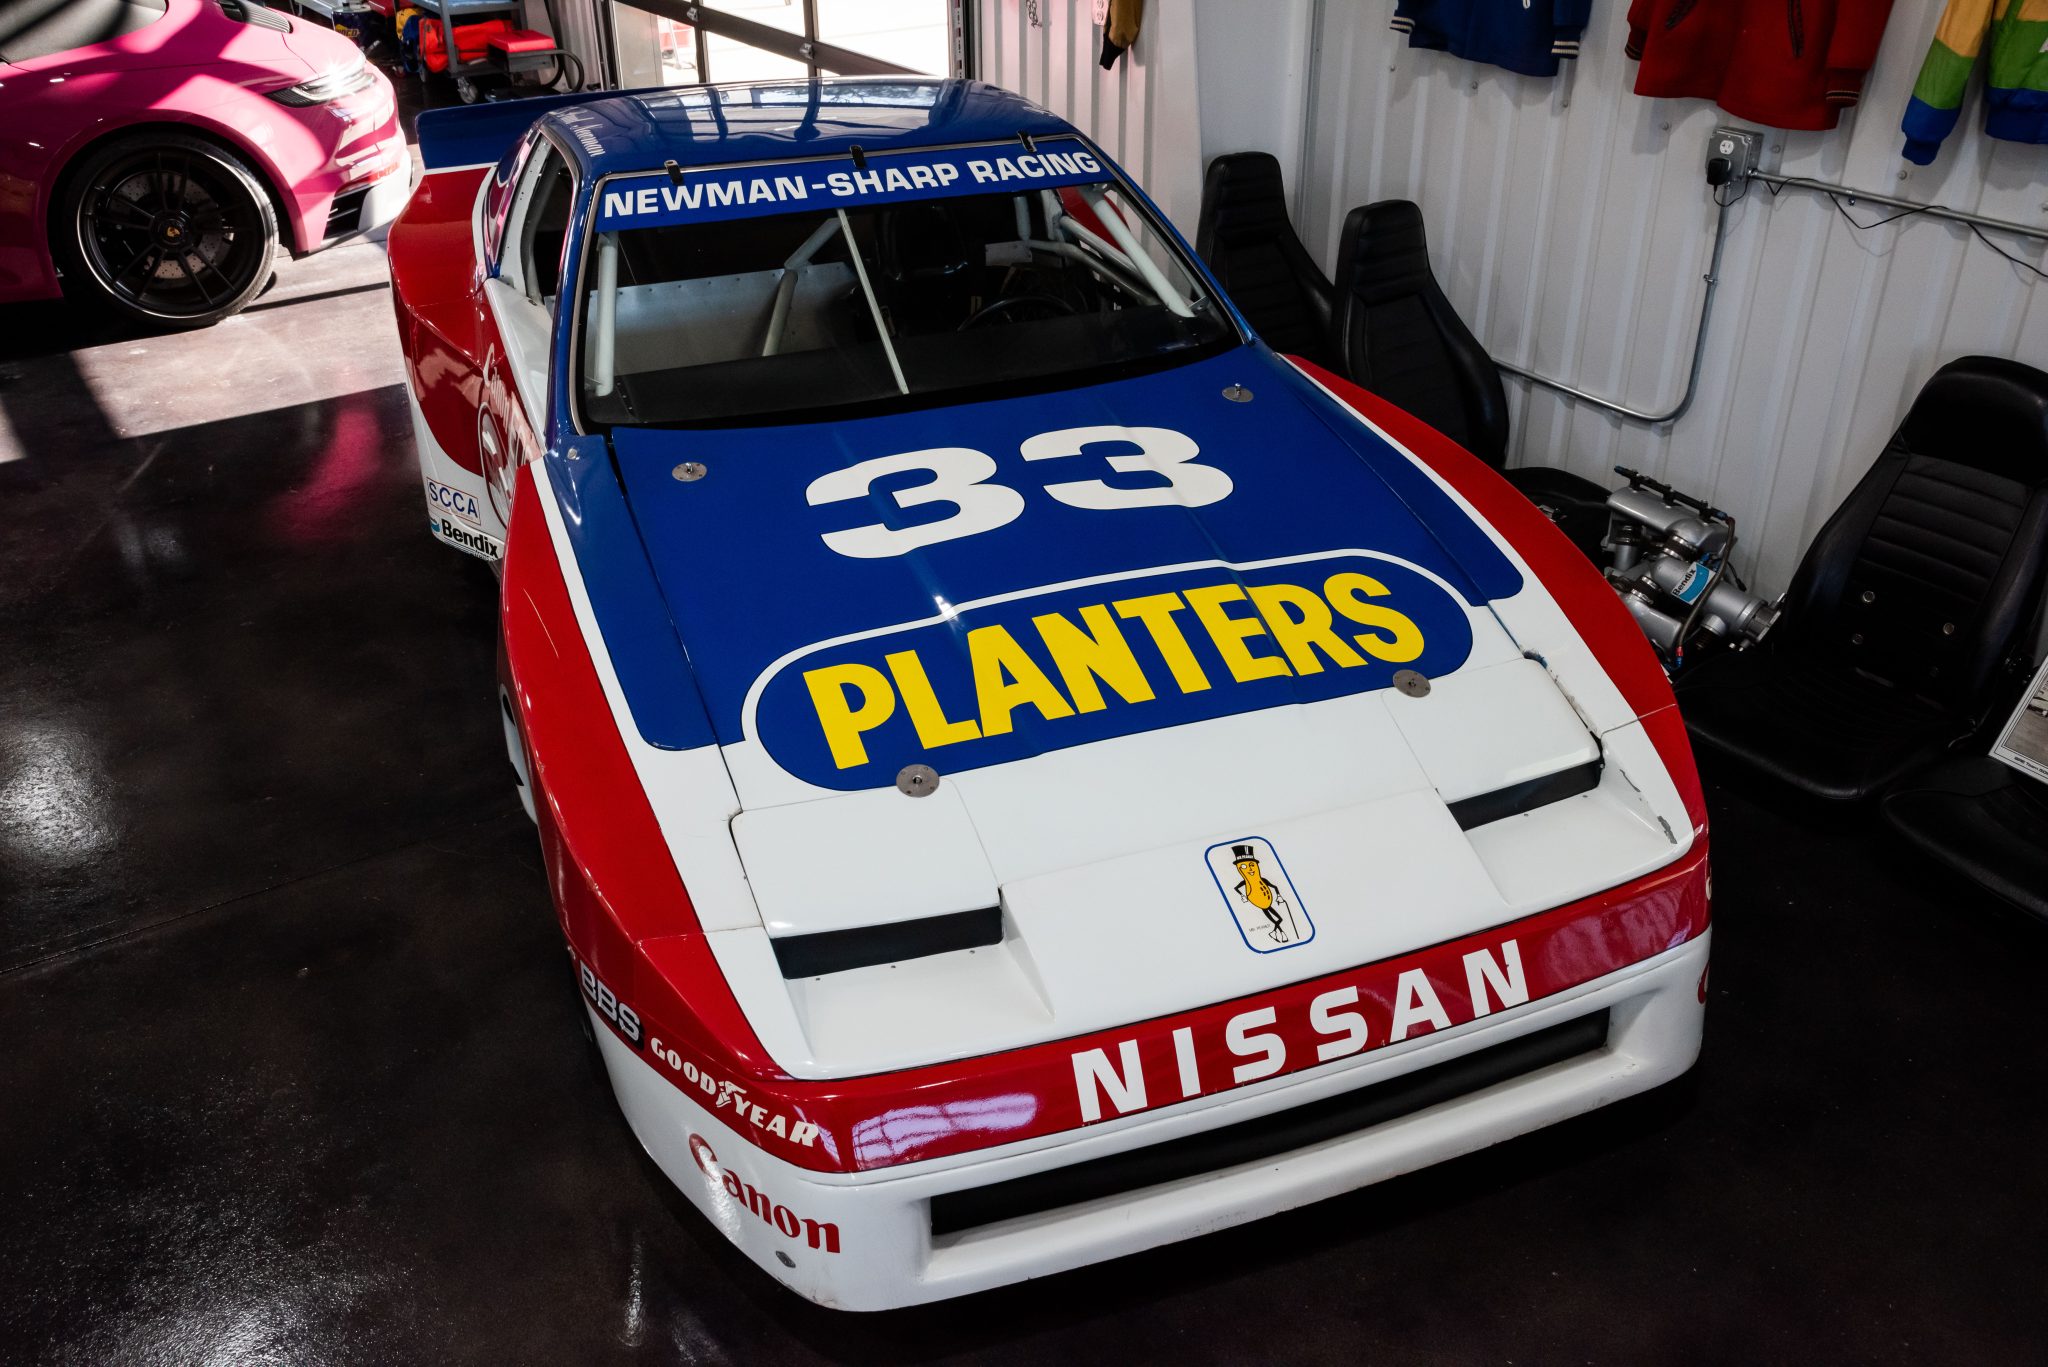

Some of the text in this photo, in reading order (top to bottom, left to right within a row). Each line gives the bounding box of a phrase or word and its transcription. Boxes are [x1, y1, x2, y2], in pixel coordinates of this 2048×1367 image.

[604, 151, 1101, 218] NEWMAN-SHARP RACING
[428, 481, 478, 518] SCCA
[441, 518, 499, 559] Bendix
[805, 425, 1234, 559] 33
[1672, 568, 1696, 596] Bendix
[803, 572, 1425, 770] PLANTERS
[579, 959, 642, 1042] BBS
[1071, 938, 1530, 1123] NISSAN
[650, 1036, 821, 1149] GOODYEAR
[688, 1132, 842, 1254] Canon
